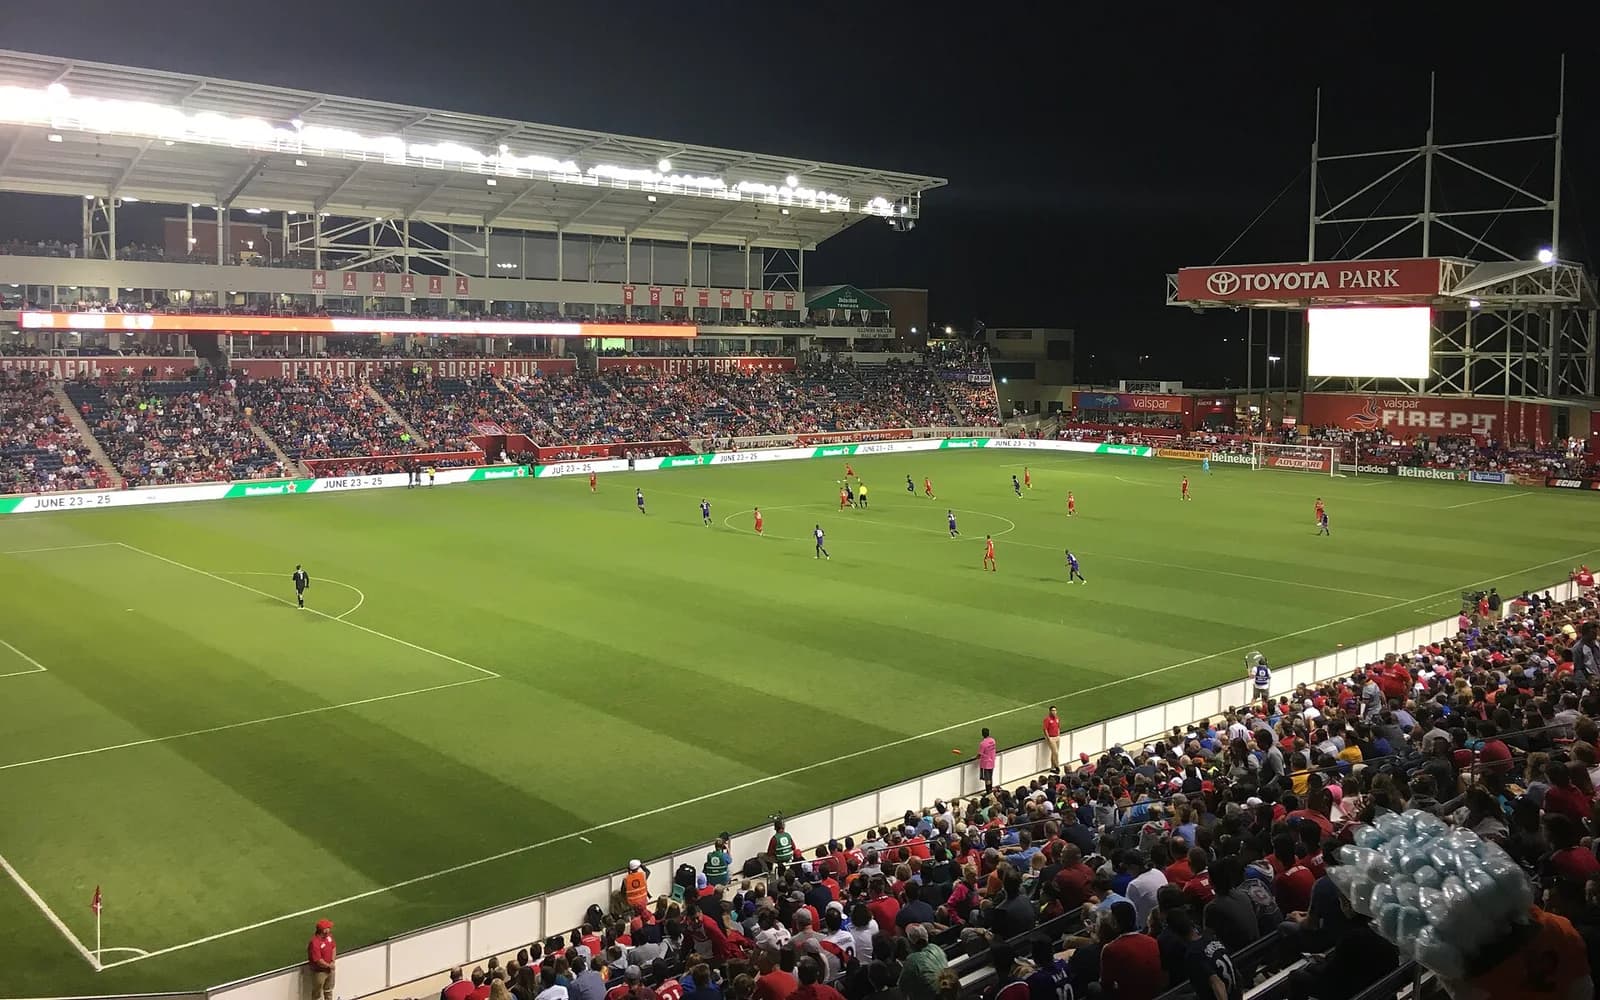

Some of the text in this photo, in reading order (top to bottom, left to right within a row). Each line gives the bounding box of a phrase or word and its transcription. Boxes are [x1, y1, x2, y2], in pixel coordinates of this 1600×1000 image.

[1241, 269, 1400, 291] TOYOTA PARK
[651, 292, 658, 301] 2
[1133, 396, 1170, 411] valspar
[1383, 398, 1420, 410] valspar
[993, 440, 1011, 448] JUNE
[720, 454, 735, 463] JUNE
[1211, 452, 1257, 465] Heineken
[566, 464, 575, 473] 23
[583, 463, 591, 472] 25
[1357, 465, 1389, 474] adidas
[1397, 466, 1455, 481] Heineken
[324, 478, 348, 489] JUNE
[350, 477, 362, 488] 23
[371, 477, 383, 486] 25
[34, 497, 66, 509] JUNE
[69, 496, 84, 507] 23
[97, 495, 111, 505] 25
